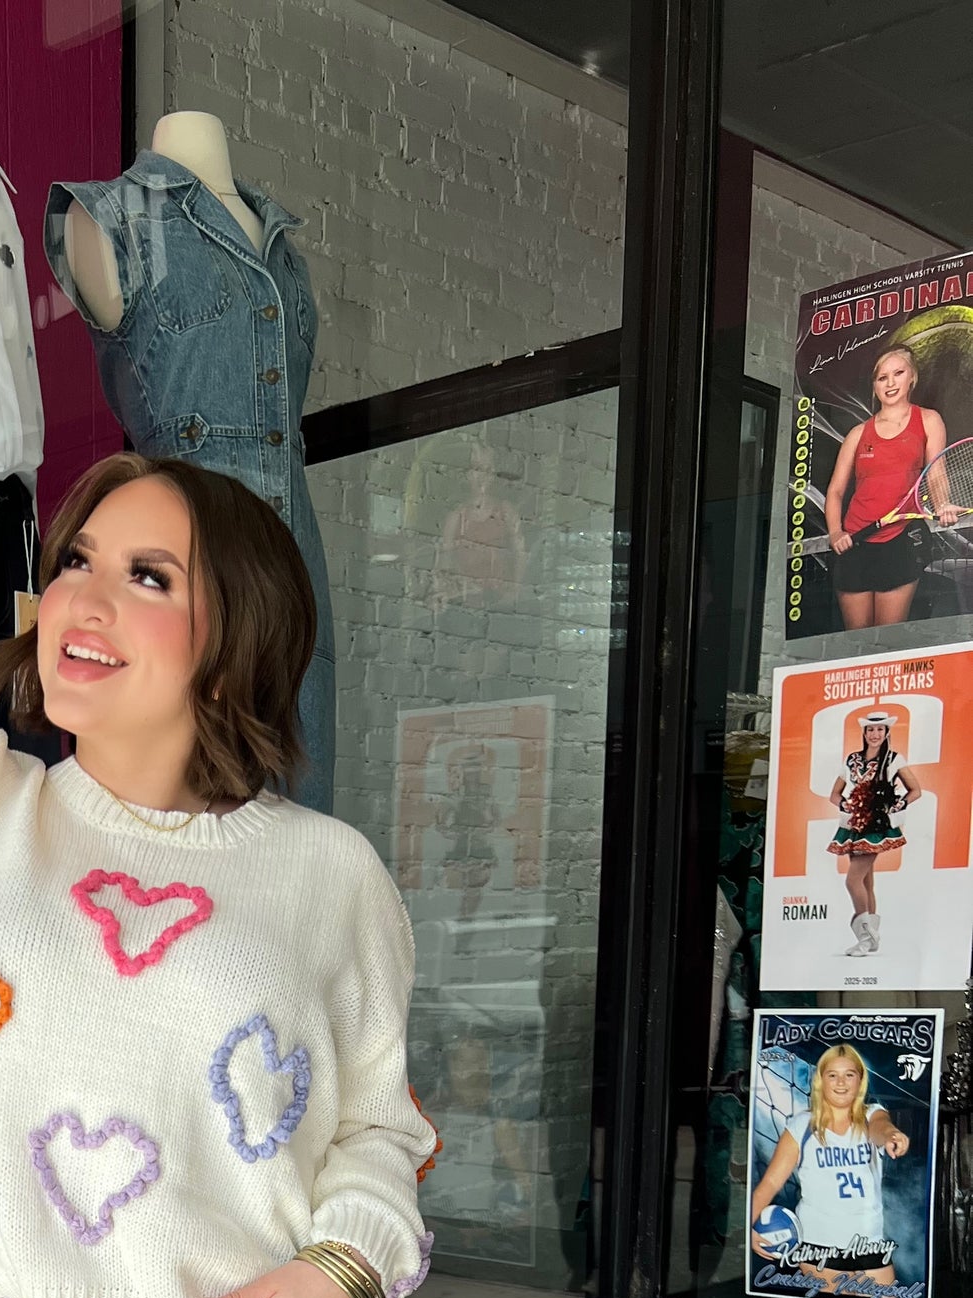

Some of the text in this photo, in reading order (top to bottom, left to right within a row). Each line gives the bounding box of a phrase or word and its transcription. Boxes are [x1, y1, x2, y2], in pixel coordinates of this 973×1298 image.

[812, 258, 964, 306] HARLINGEN HIGH SCHOOL VARSITY TENNIS
[823, 671, 934, 701] SOUTHERN STARS
[824, 659, 935, 684] HARLINGEN SOUTH HAWKS
[782, 904, 827, 921] ROMAN
[835, 1171, 865, 1199] 24
[777, 1242, 840, 1272] Kathryn
